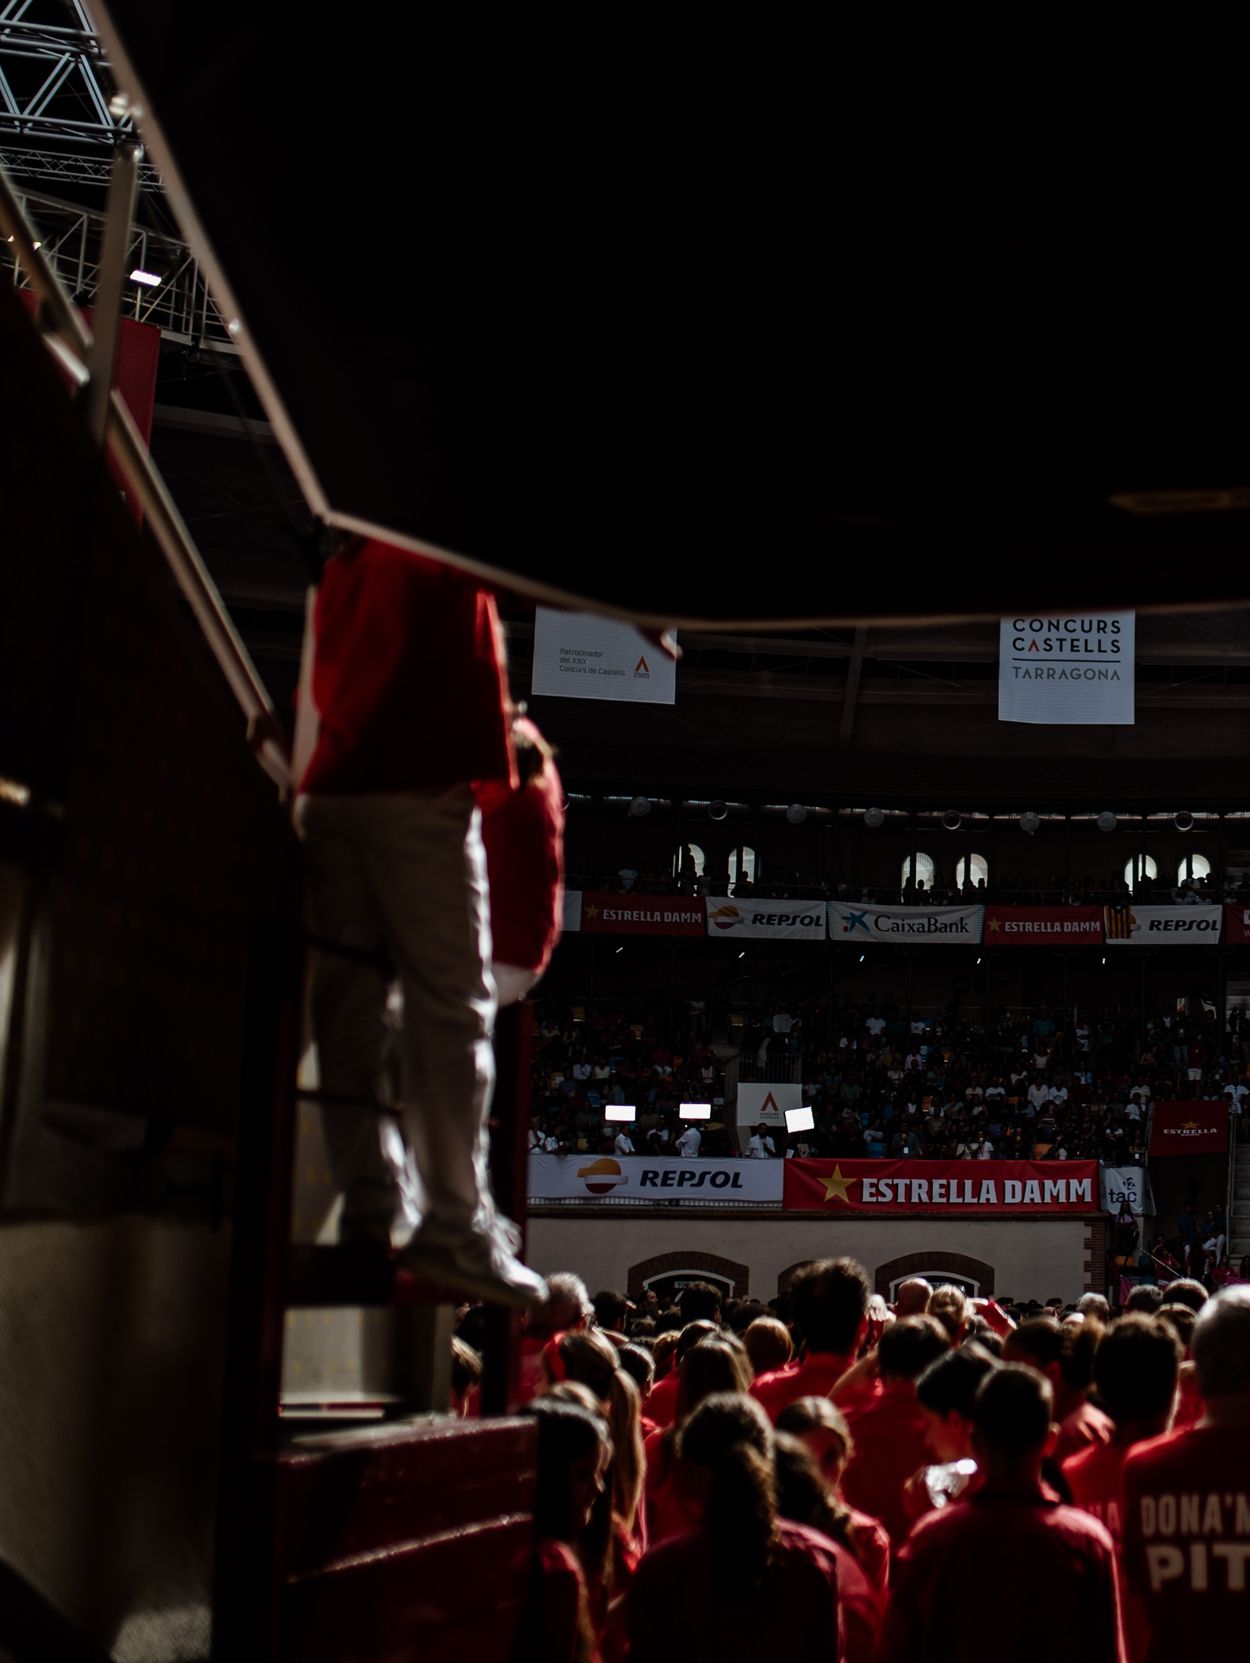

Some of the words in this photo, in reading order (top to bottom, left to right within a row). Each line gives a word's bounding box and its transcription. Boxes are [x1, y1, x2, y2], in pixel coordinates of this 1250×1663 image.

[1012, 618, 1121, 634] CONCURS
[1012, 637, 1121, 653] CASTELLS
[560, 648, 604, 658] Patrocinador
[559, 665, 587, 674] Concurs
[588, 667, 597, 675] de
[598, 667, 626, 677] Castells
[1012, 666, 1121, 681] TARRAGONA
[602, 908, 662, 922] ESTRELLA
[663, 911, 703, 924] DAMM
[750, 913, 824, 927] REPSOL
[874, 914, 970, 934] CaixaBank
[1004, 920, 1062, 933] ESTRELLA
[1063, 920, 1101, 933] DAMM
[1148, 918, 1219, 932] REPSOL
[1163, 1127, 1218, 1135] ESTRELLA
[639, 1169, 744, 1189] REPSOL
[861, 1177, 999, 1204] ESTRELLA
[1003, 1177, 1093, 1204] DAMM
[1108, 1188, 1137, 1204] tac
